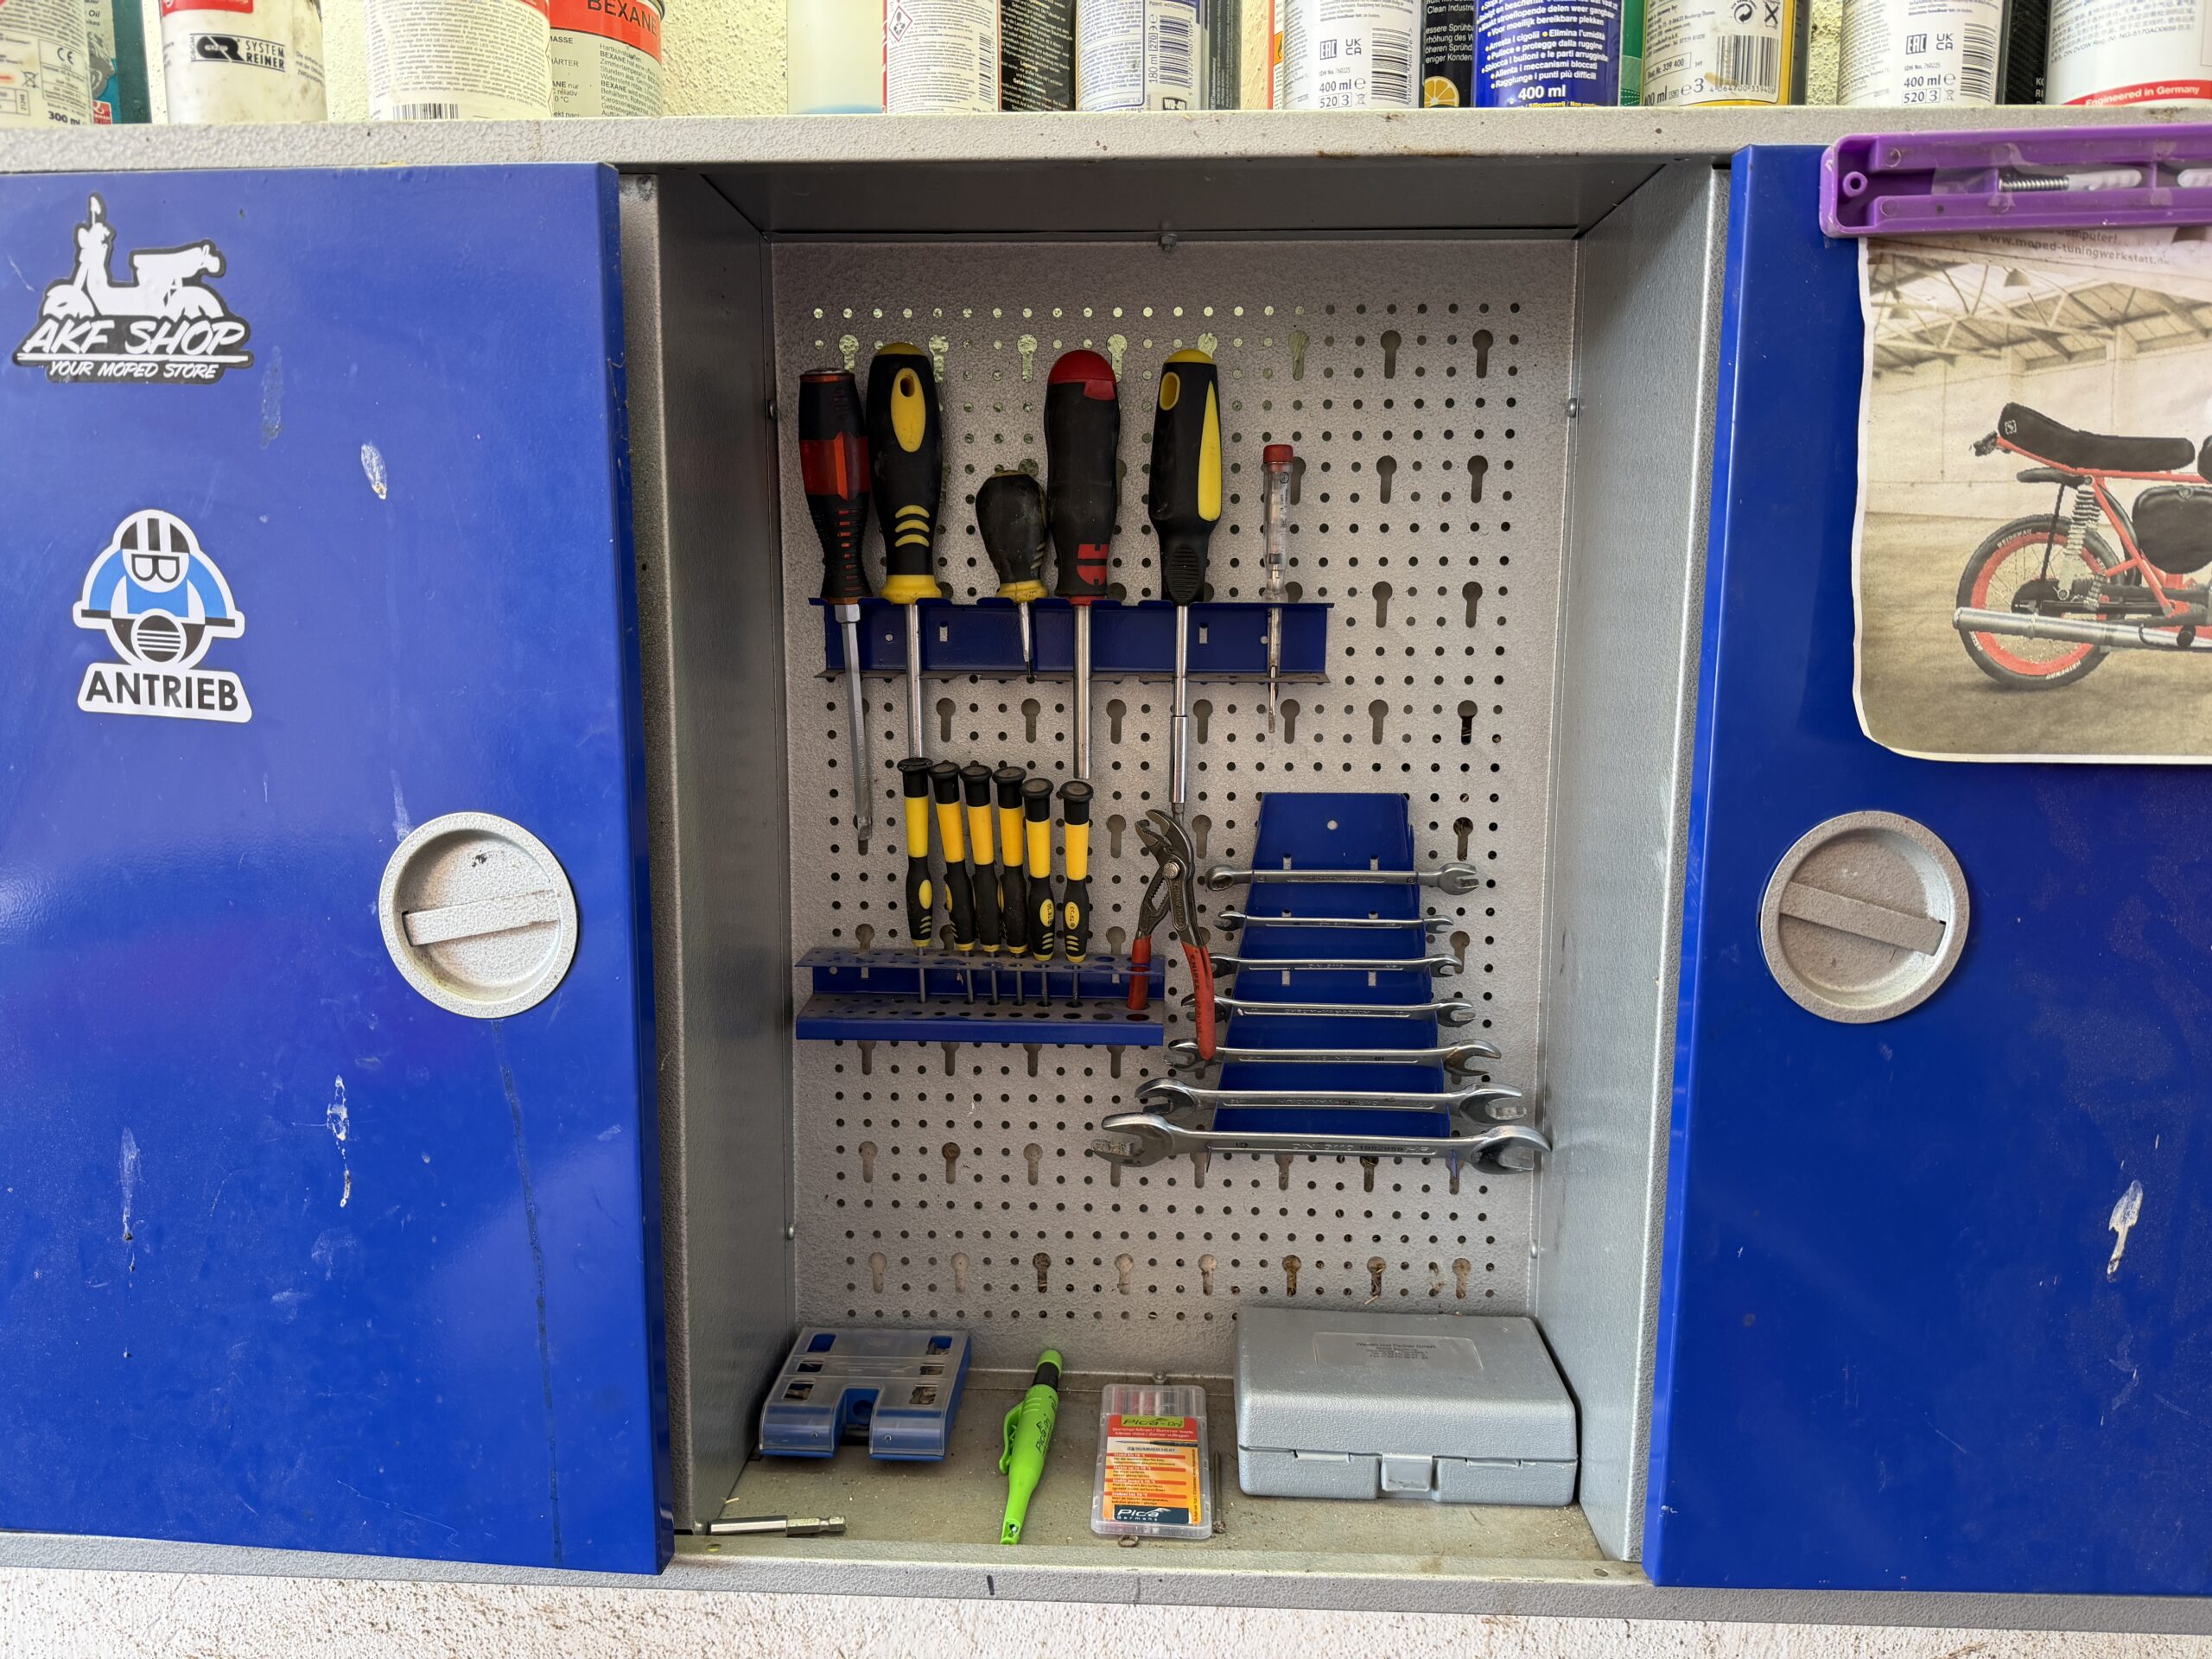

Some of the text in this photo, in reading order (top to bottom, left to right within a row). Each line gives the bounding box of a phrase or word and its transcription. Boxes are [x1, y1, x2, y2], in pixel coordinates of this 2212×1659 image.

[1427, 5, 1446, 14] Clean
[1548, 4, 1570, 13] delen
[588, 0, 661, 36] BEXANE
[1491, 26, 1506, 36] Voor
[1536, 14, 1578, 24] bereikbare
[1579, 16, 1605, 26] plekken
[1426, 23, 1474, 35] essere Sprühb
[1548, 29, 1578, 38] Elimina
[1346, 38, 1362, 47] UK
[1426, 33, 1466, 43] rhöhung des
[1936, 33, 1953, 41] UK
[245, 41, 285, 57] SYSTEM
[1426, 43, 1472, 54] öheren Sprühd
[1522, 40, 1557, 53] protegge
[1558, 39, 1577, 48] dalla
[1578, 41, 1604, 50] ruggine
[245, 52, 285, 69] REINER
[600, 50, 626, 64] BEXANE
[1148, 54, 1158, 66] ml
[1426, 55, 1446, 65] eniger
[1513, 51, 1540, 63] bulloni
[1547, 50, 1555, 59] le
[1556, 50, 1574, 59] parti
[1495, 67, 1519, 79] Allenta
[1523, 60, 1569, 71] meccanismi
[1571, 60, 1598, 69] bloccati
[1662, 61, 1673, 72] 339
[1674, 58, 1685, 67] 400
[1148, 67, 1158, 84] 180
[1495, 74, 1533, 88] Raggiunge
[1538, 71, 1559, 81] punti
[1560, 69, 1573, 79] più
[1904, 76, 1924, 88] 400
[1927, 74, 1941, 86] ml
[601, 79, 627, 92] BEXANE
[1319, 80, 1337, 93] 400
[1339, 78, 1351, 91] ml
[1517, 85, 1567, 100] 400 ml
[1657, 85, 1668, 104] ml
[1904, 92, 1925, 104] 520
[2085, 85, 2200, 105] Engineered in Germany
[1320, 97, 1338, 109] 520
[48, 111, 67, 123] 300
[22, 318, 246, 357] AKF SHOP
[49, 360, 219, 378] YOUR MOPED STORE
[85, 671, 238, 712] ANTRIEB
[1190, 954, 1201, 991] KNIPEX
[1117, 1509, 1160, 1517] Pica
